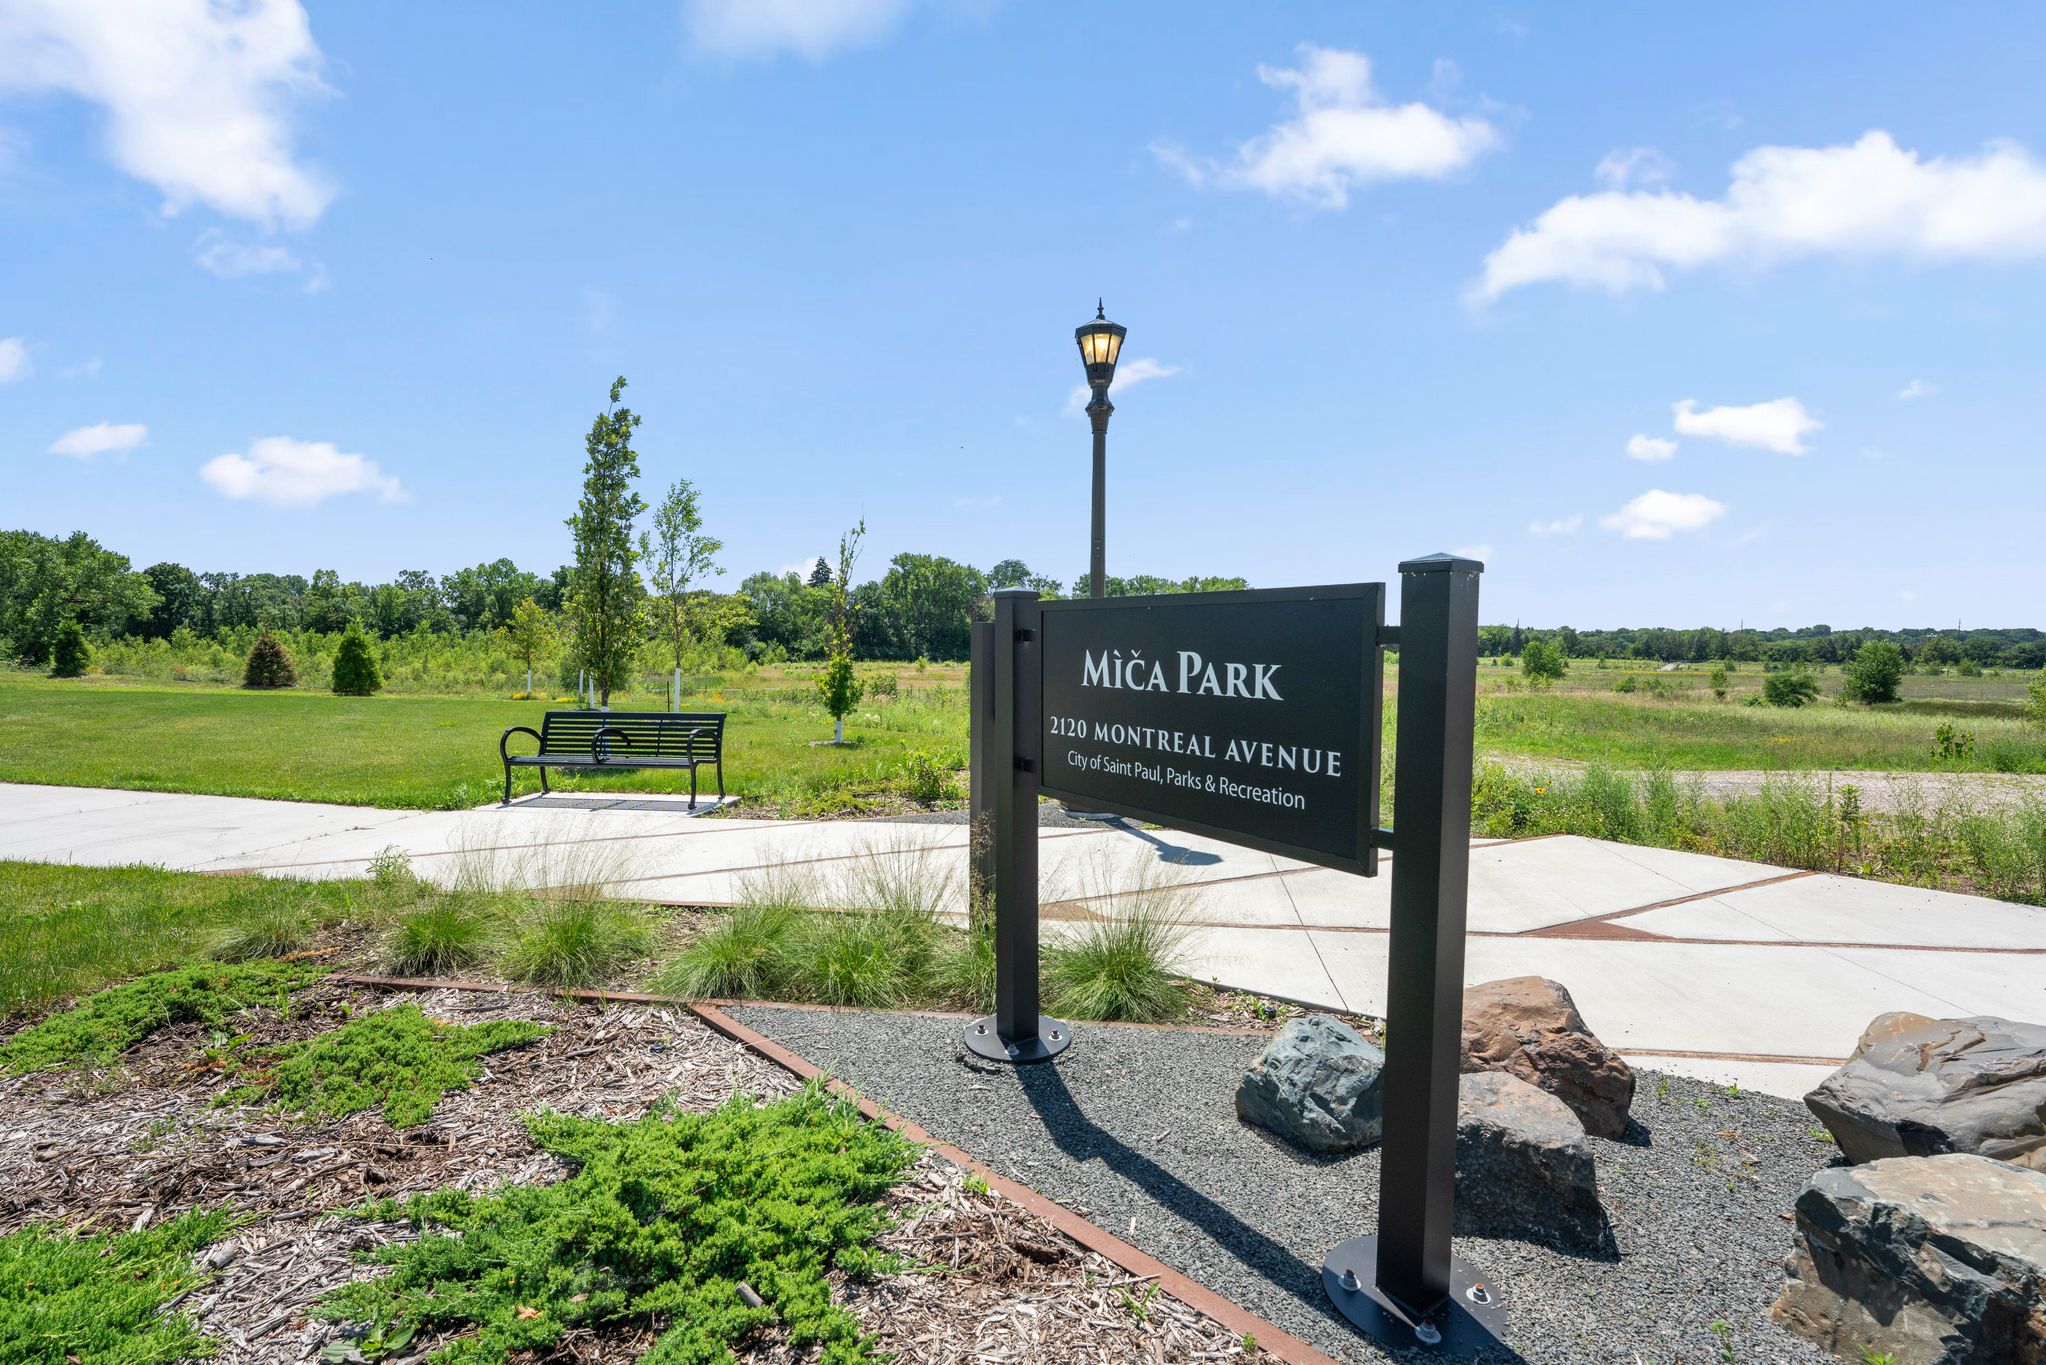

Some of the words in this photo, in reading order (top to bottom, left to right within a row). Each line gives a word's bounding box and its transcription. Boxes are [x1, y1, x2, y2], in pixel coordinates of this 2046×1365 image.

[1176, 650, 1285, 701] PARK
[1049, 715, 1087, 739] 2120
[1093, 721, 1216, 759] MONTREAL
[1223, 738, 1342, 777] AVENUE
[1067, 750, 1088, 772] City
[1089, 754, 1102, 771] of
[1103, 756, 1132, 777] Saint
[1134, 761, 1164, 785] Paul,
[1166, 768, 1202, 790] Parks
[1204, 774, 1216, 793] &
[1219, 776, 1306, 810] Recreation
